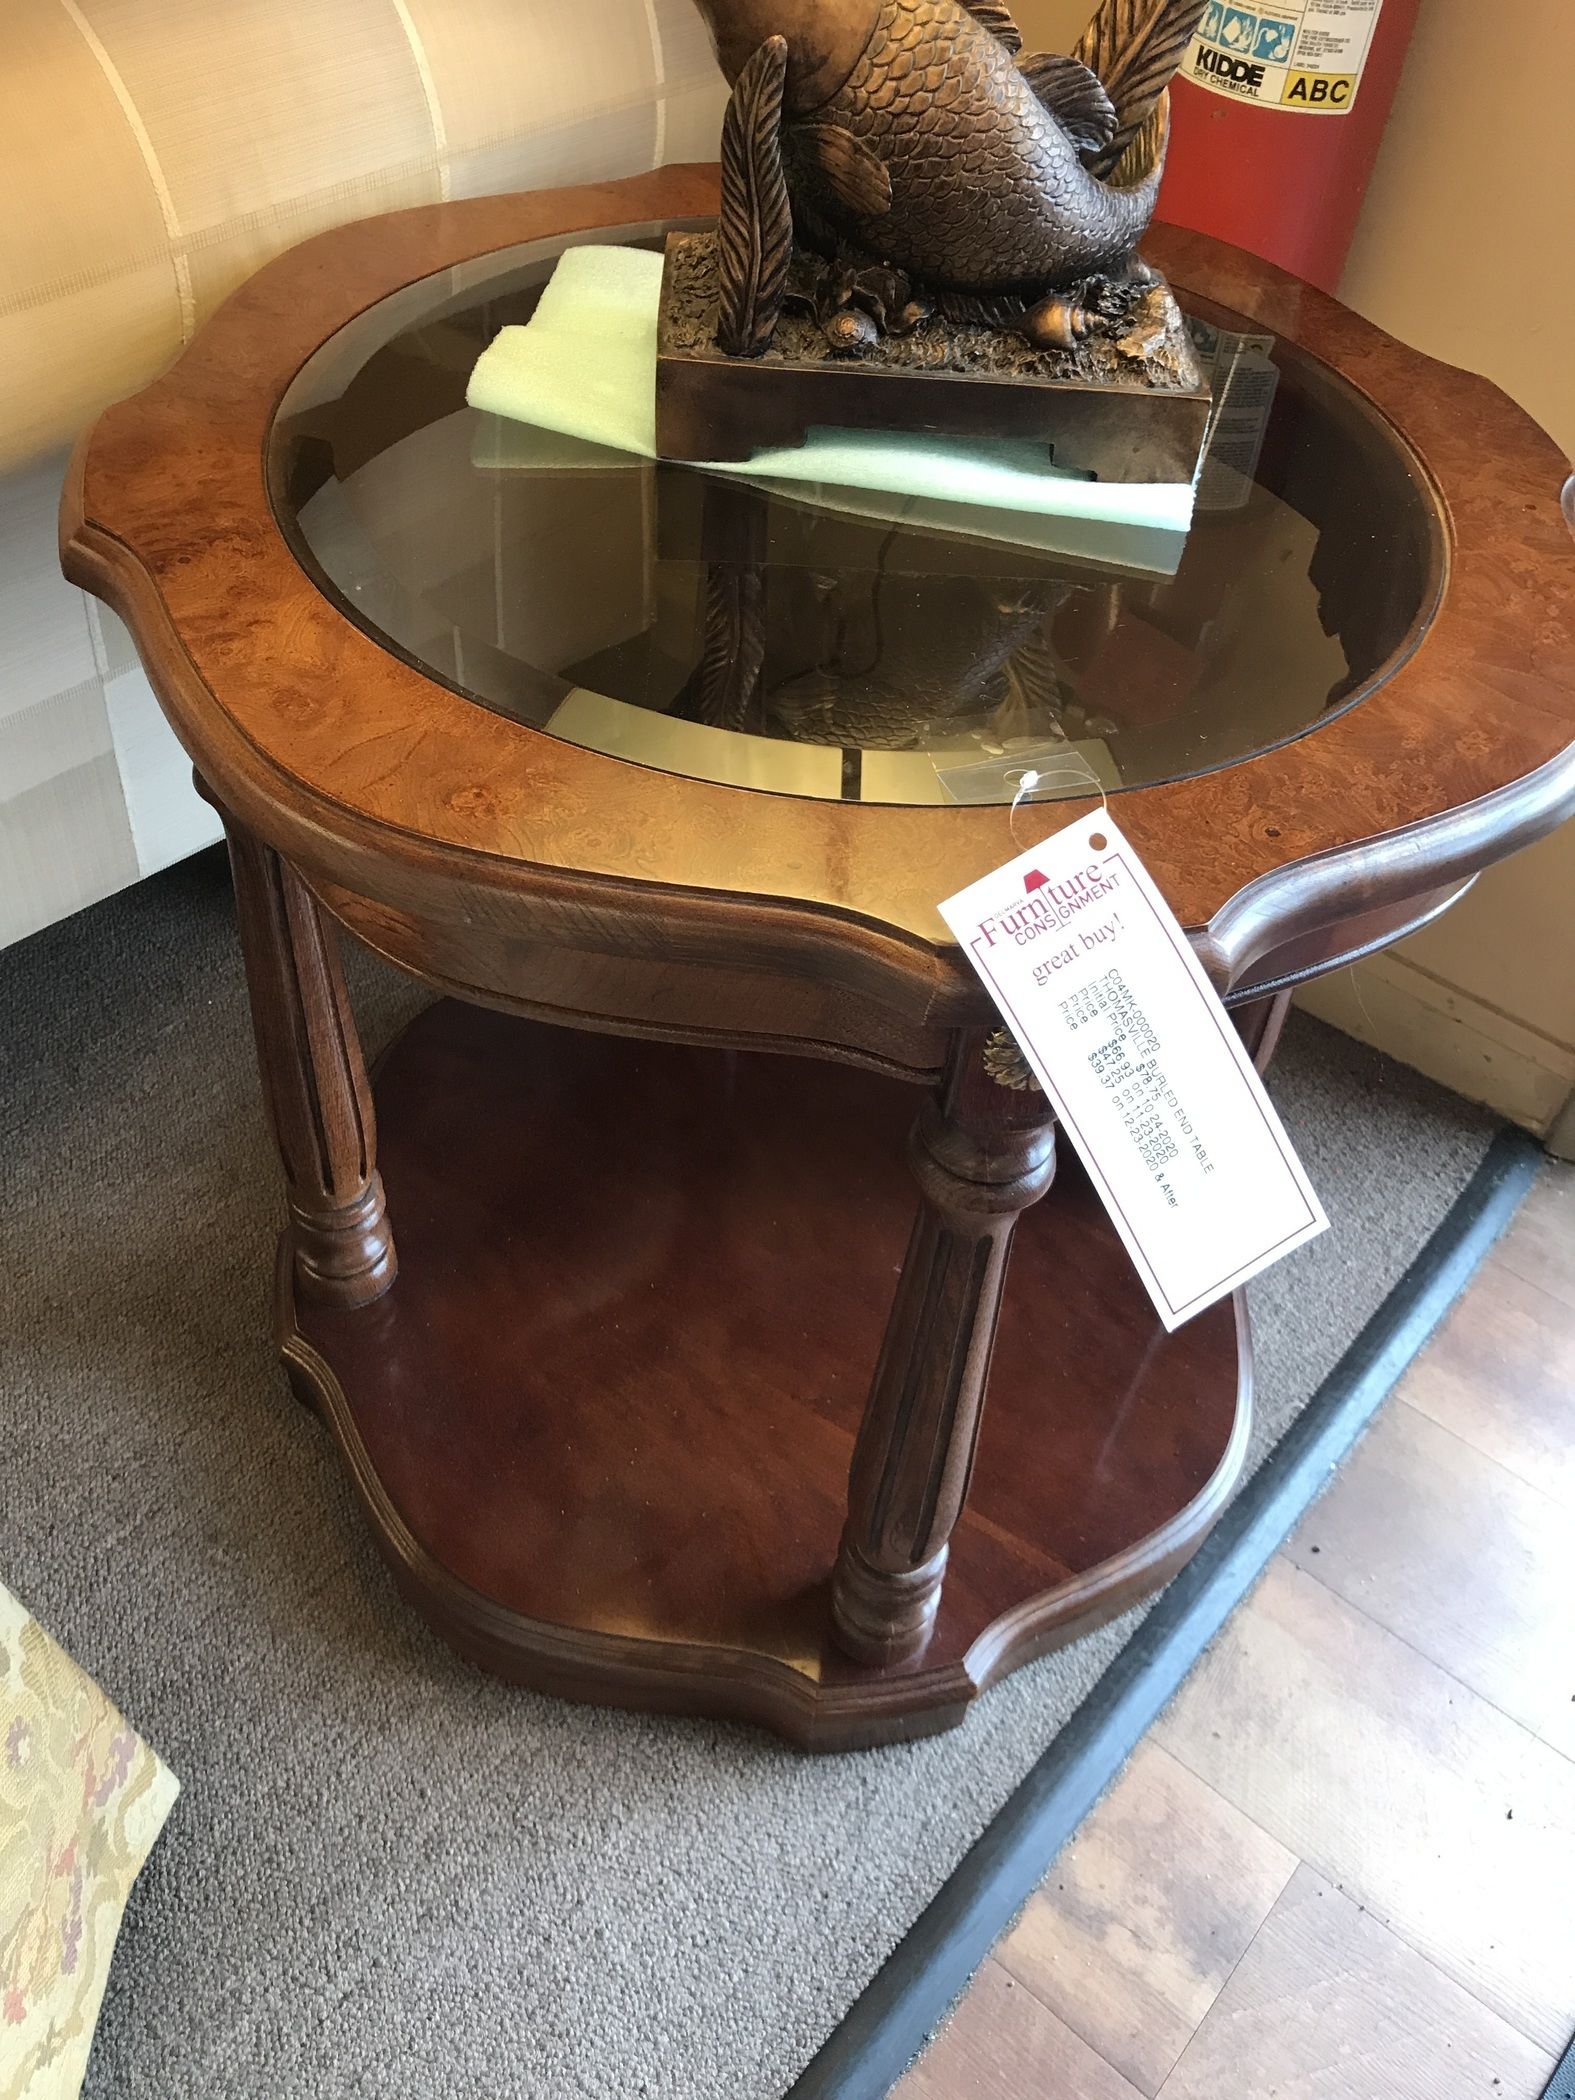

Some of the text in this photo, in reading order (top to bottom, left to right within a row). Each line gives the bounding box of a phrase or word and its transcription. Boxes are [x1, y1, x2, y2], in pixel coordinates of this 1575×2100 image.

[1193, 65, 1260, 97] DRY CHEMICAL
[1196, 44, 1266, 88] KIDDE
[1288, 77, 1349, 103] ABC
[977, 864, 1103, 948] Furniture
[1014, 873, 1121, 946] CONSIGNMENT
[1032, 912, 1125, 987] great buy!
[1078, 987, 1098, 1018] Price
[1108, 1038, 1135, 1078] $66.93
[1131, 1082, 1145, 1097] on
[1088, 980, 1162, 1101] Initial Price $78.75
[1108, 968, 1161, 1052] C04MK-000020
[1058, 1000, 1180, 1209] Price $39.37 on 12-23-2020 & After
[1068, 994, 1169, 1165] Price $47.25 on 11-23-2020
[1099, 975, 1215, 1174] THOMASVILLE BURLED END TABLE
